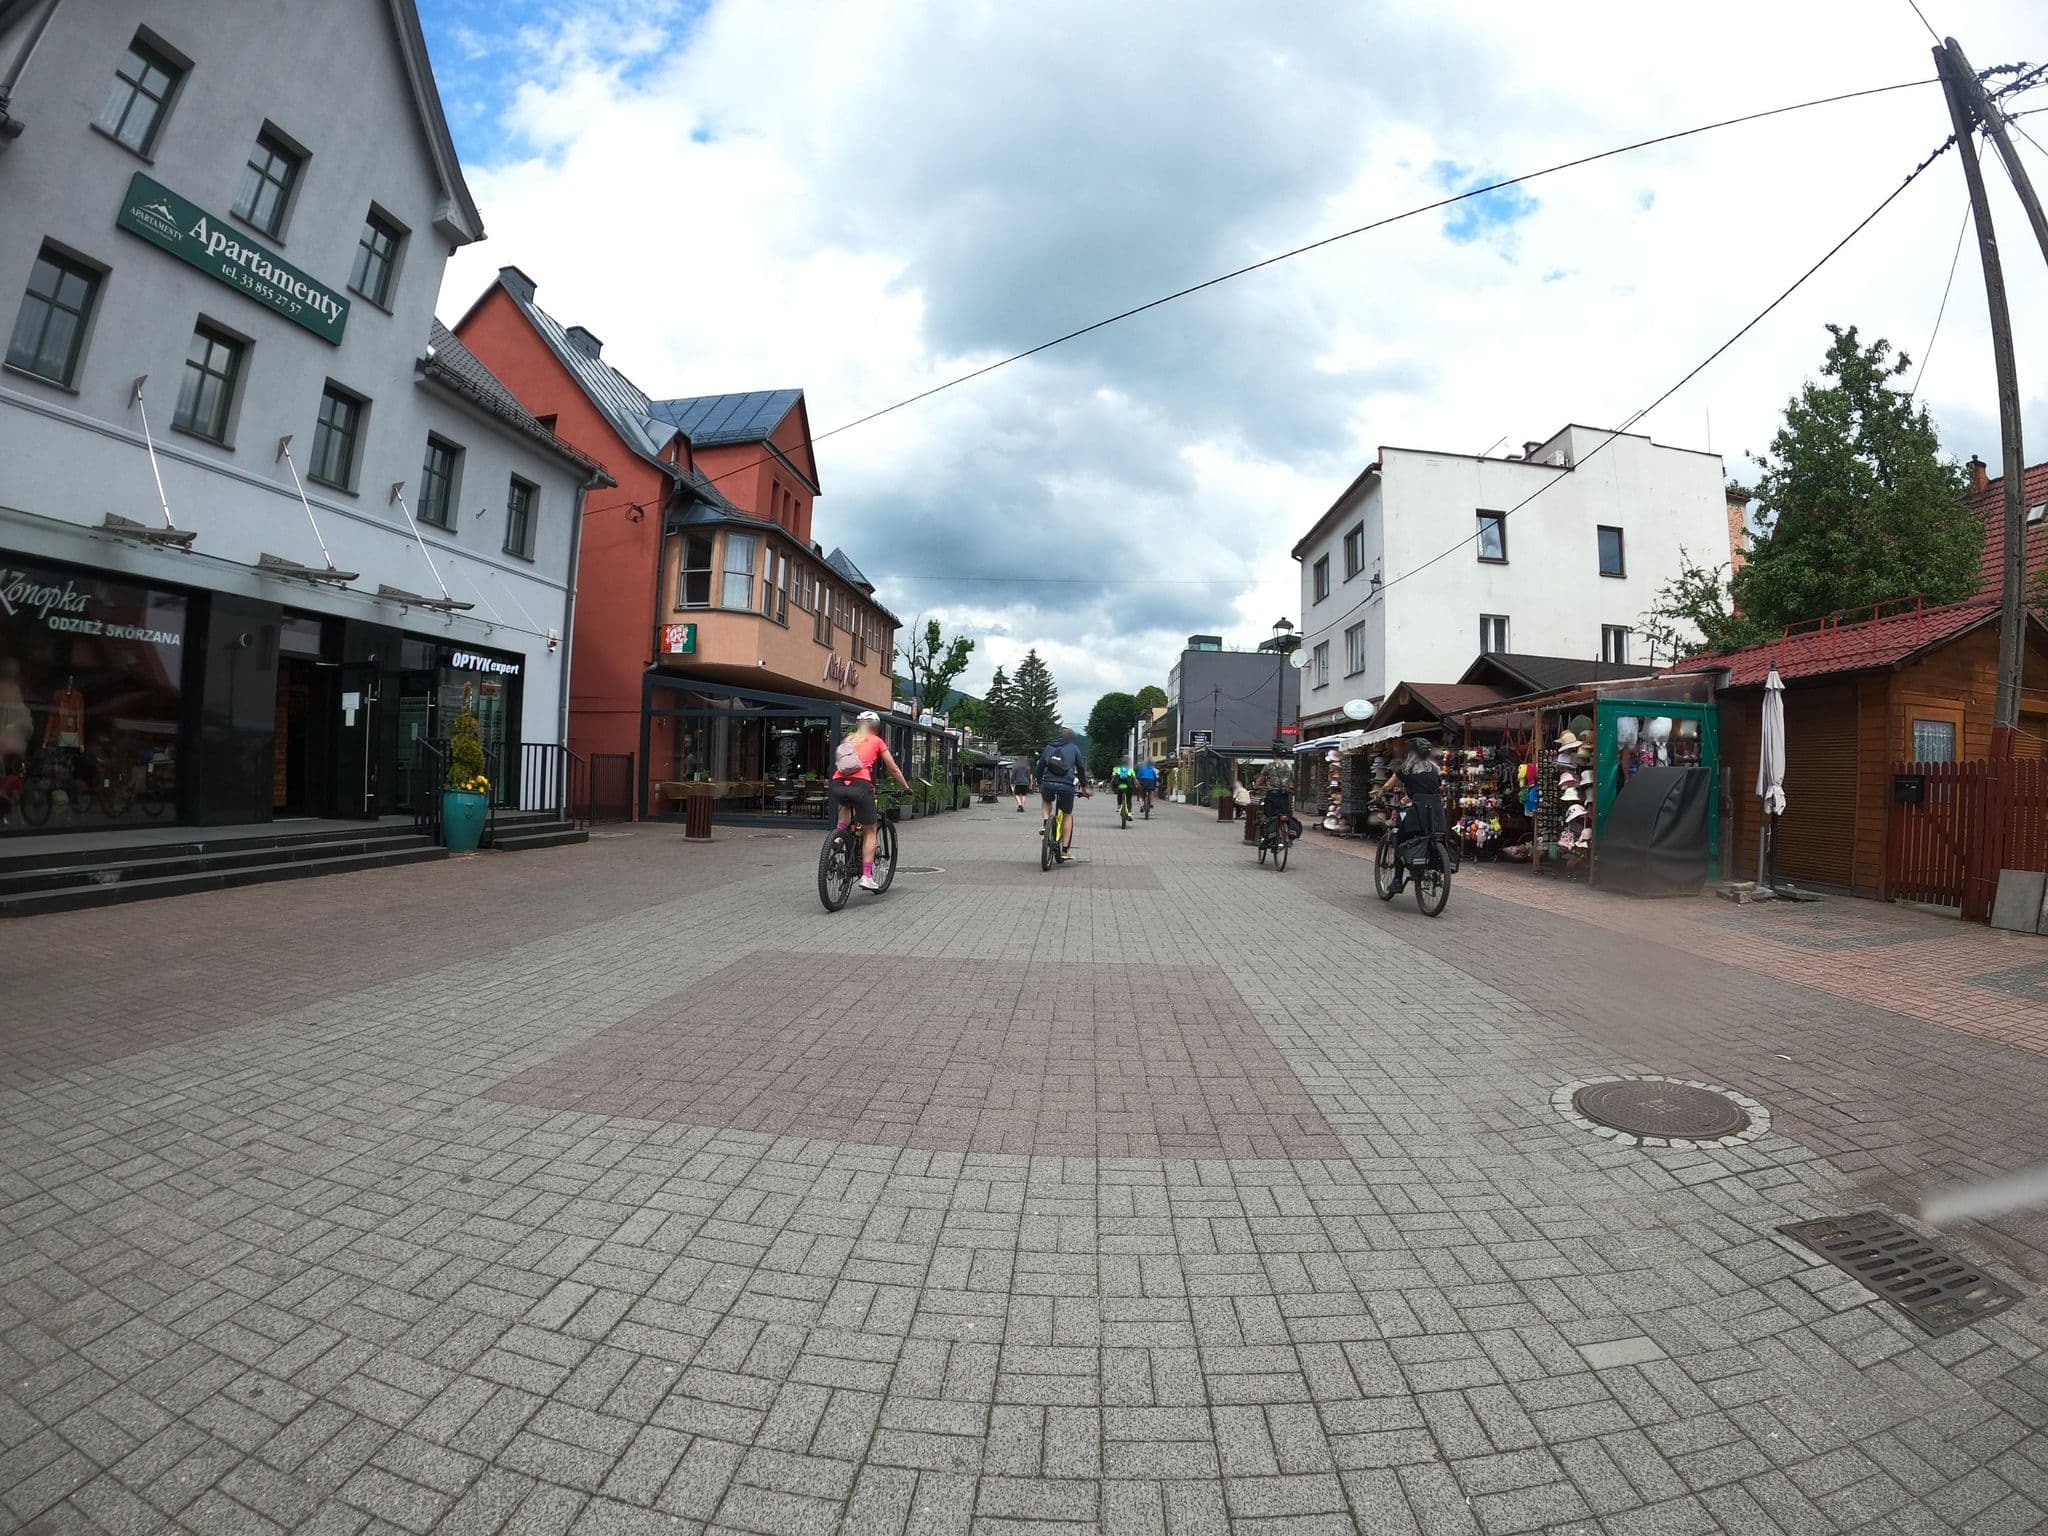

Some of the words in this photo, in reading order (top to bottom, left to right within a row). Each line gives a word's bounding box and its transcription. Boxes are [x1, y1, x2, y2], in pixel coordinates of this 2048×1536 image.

[130, 207, 183, 240] APARTAMENTY
[189, 217, 343, 324] Apartamenty
[222, 263, 237, 280] tel.
[240, 273, 253, 288] 33
[255, 282, 273, 299] 855
[276, 293, 288, 307] 27
[290, 302, 302, 314] 57
[49, 615, 102, 635] ODZIEŻ
[106, 624, 181, 646] SKÓRZANA
